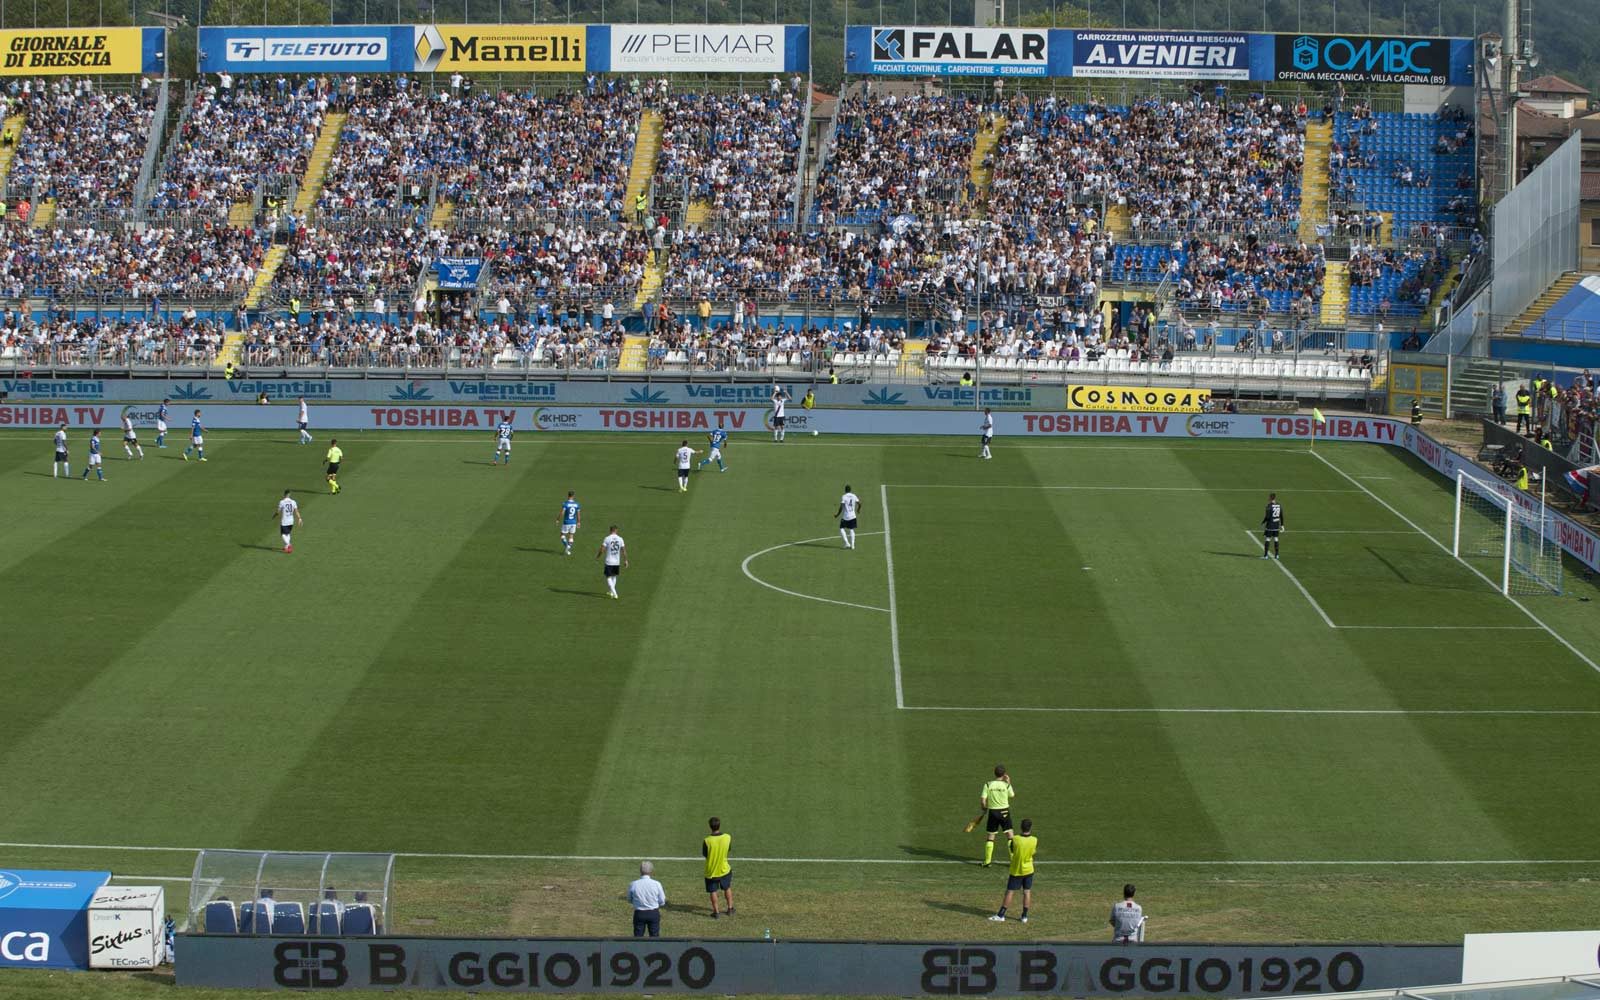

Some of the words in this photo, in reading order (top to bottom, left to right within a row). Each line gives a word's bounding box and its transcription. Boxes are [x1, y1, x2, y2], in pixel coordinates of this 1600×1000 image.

[10, 35, 107, 51] GIORNALE
[652, 34, 774, 53] PEIMAR
[913, 32, 1044, 60] FALAR
[1077, 33, 1136, 42] CARROZZERIA
[1138, 34, 1195, 43] INDUSTRIALE
[1196, 36, 1246, 44] BRESCIANA
[271, 43, 381, 56] TELETUTTO
[450, 36, 581, 61] Manelli
[1086, 43, 1236, 67] A.VENIERI
[1324, 38, 1431, 73] OMBC
[4, 53, 26, 67] DI
[29, 52, 111, 67] BRESCIA
[873, 64, 905, 72] FACCIATE
[906, 65, 942, 73] CONTINUE
[948, 65, 994, 74] CARPENTERIE
[1001, 66, 1045, 74] SERRAMENTI
[1278, 72, 1316, 80] OFFICINA
[1317, 73, 1365, 81] MECCANICA
[1371, 74, 1392, 82] VILLA
[1394, 75, 1429, 83] CARCINA
[1430, 75, 1446, 85] (BS)
[4, 380, 104, 392] Valentini
[227, 380, 332, 393] Valentini
[449, 381, 556, 395] Valentini
[923, 386, 1032, 401] Valentini
[74, 408, 105, 424] TV
[371, 408, 479, 426] TOSHIBA
[484, 409, 516, 426] TV
[1130, 406, 1203, 414] CONDENSAZION
[599, 410, 708, 428] TOSHIBA
[713, 411, 746, 428] TV
[1023, 415, 1131, 433] TOSHIBA
[1137, 416, 1169, 433] TV
[1261, 417, 1369, 438] TOSHIBA
[1373, 422, 1397, 441] TV
[569, 507, 576, 516] 9
[0, 931, 50, 962] ca
